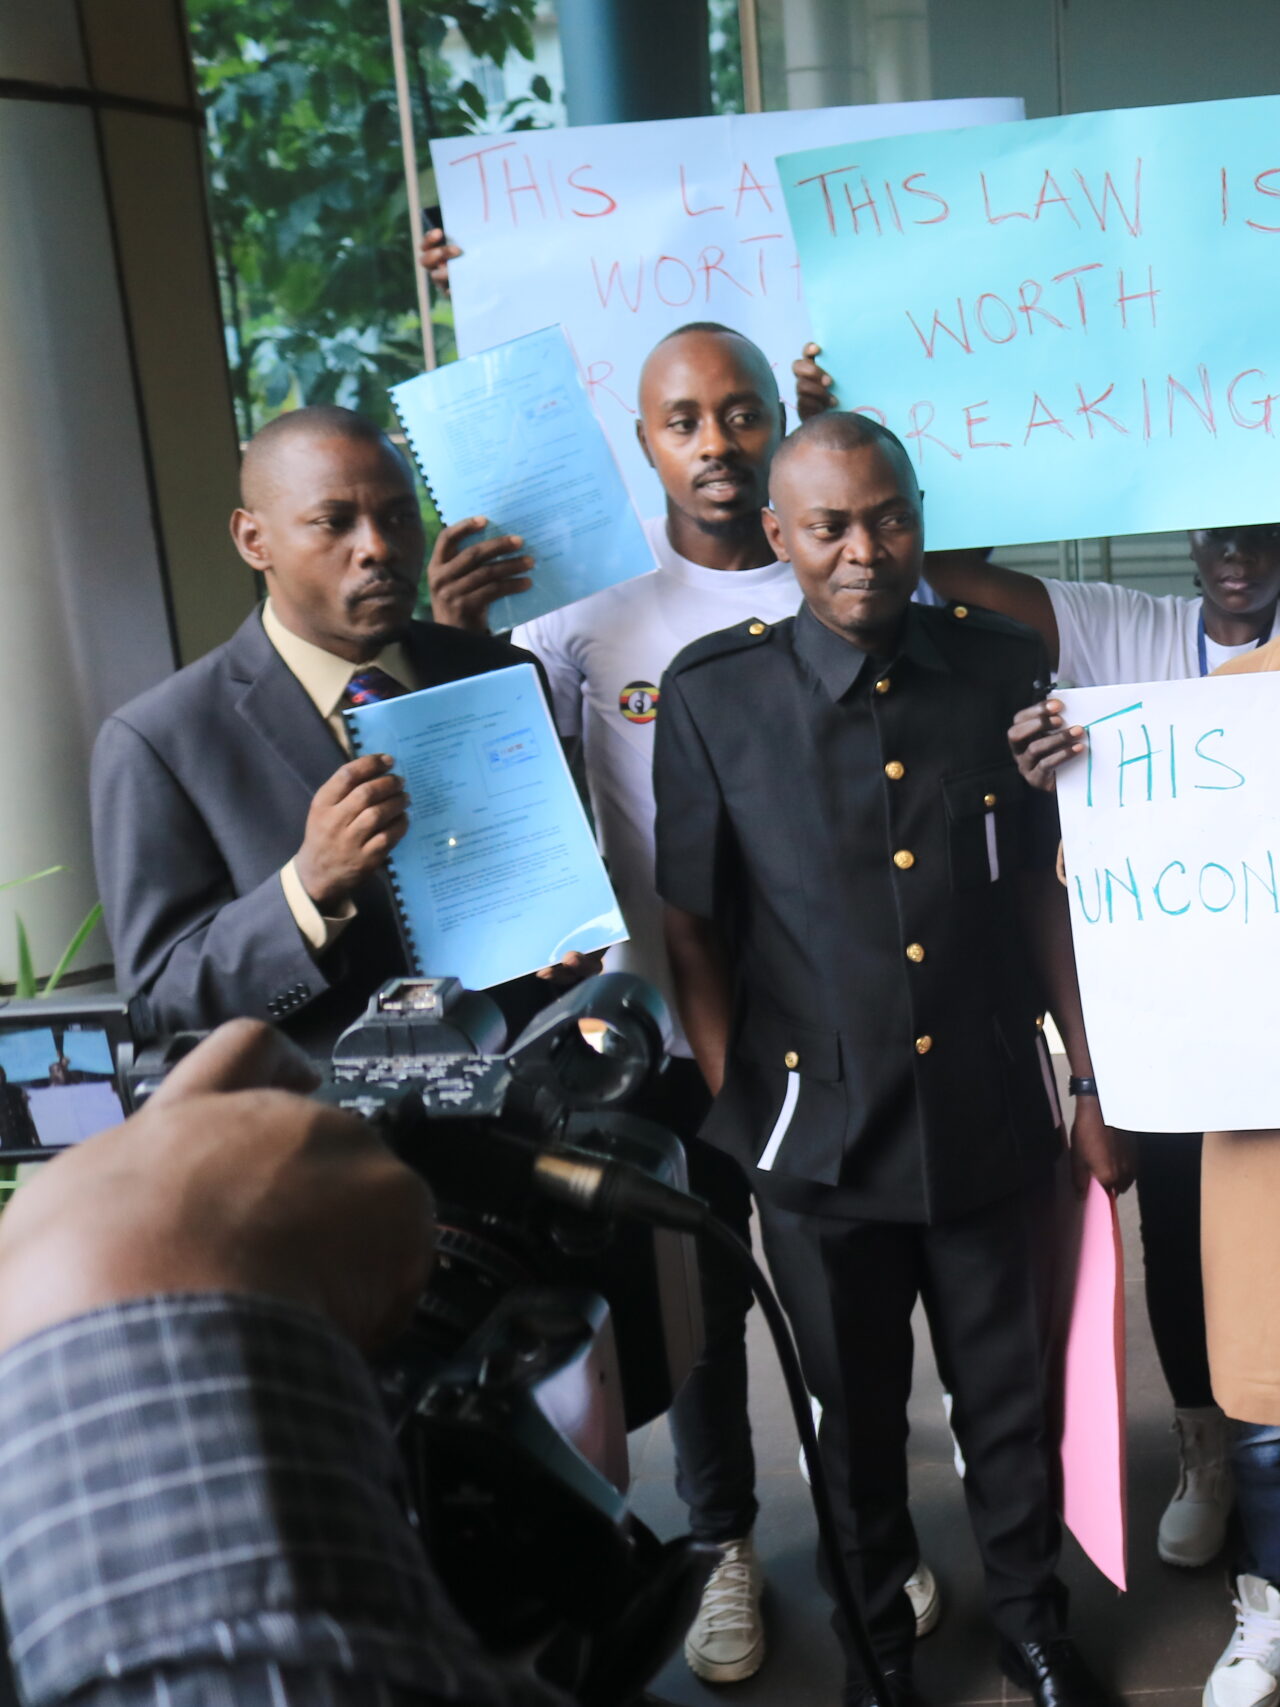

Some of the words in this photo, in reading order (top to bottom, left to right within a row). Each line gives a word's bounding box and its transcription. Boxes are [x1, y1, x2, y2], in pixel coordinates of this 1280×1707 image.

[450, 141, 620, 226] THIS
[680, 162, 773, 217] LA
[796, 166, 950, 236] THIS
[980, 157, 1142, 238] LAW
[906, 263, 1160, 360] WORTH
[1083, 702, 1246, 808] THIS
